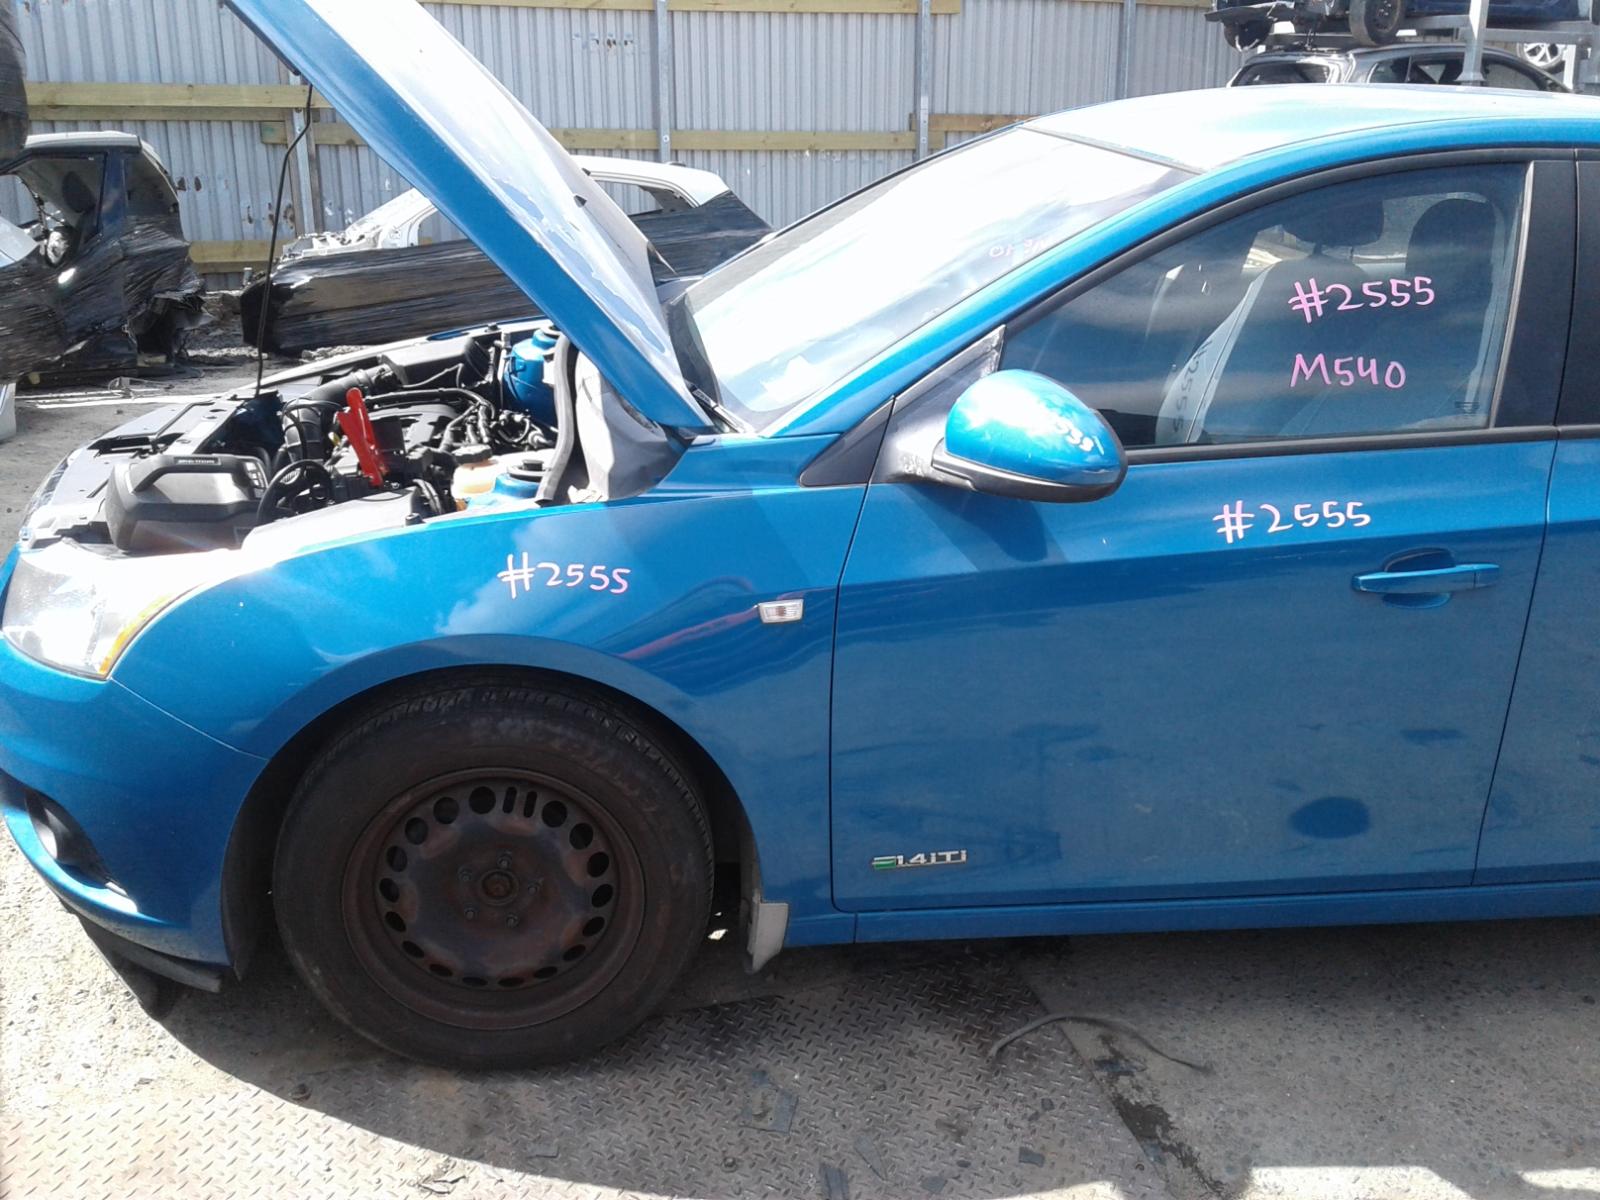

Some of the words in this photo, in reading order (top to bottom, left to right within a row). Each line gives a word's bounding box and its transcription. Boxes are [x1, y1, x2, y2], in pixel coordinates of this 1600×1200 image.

[1287, 275, 1436, 325] #2555
[1289, 352, 1407, 389] M540
[1212, 499, 1372, 545] #2555
[496, 551, 632, 600] #2555
